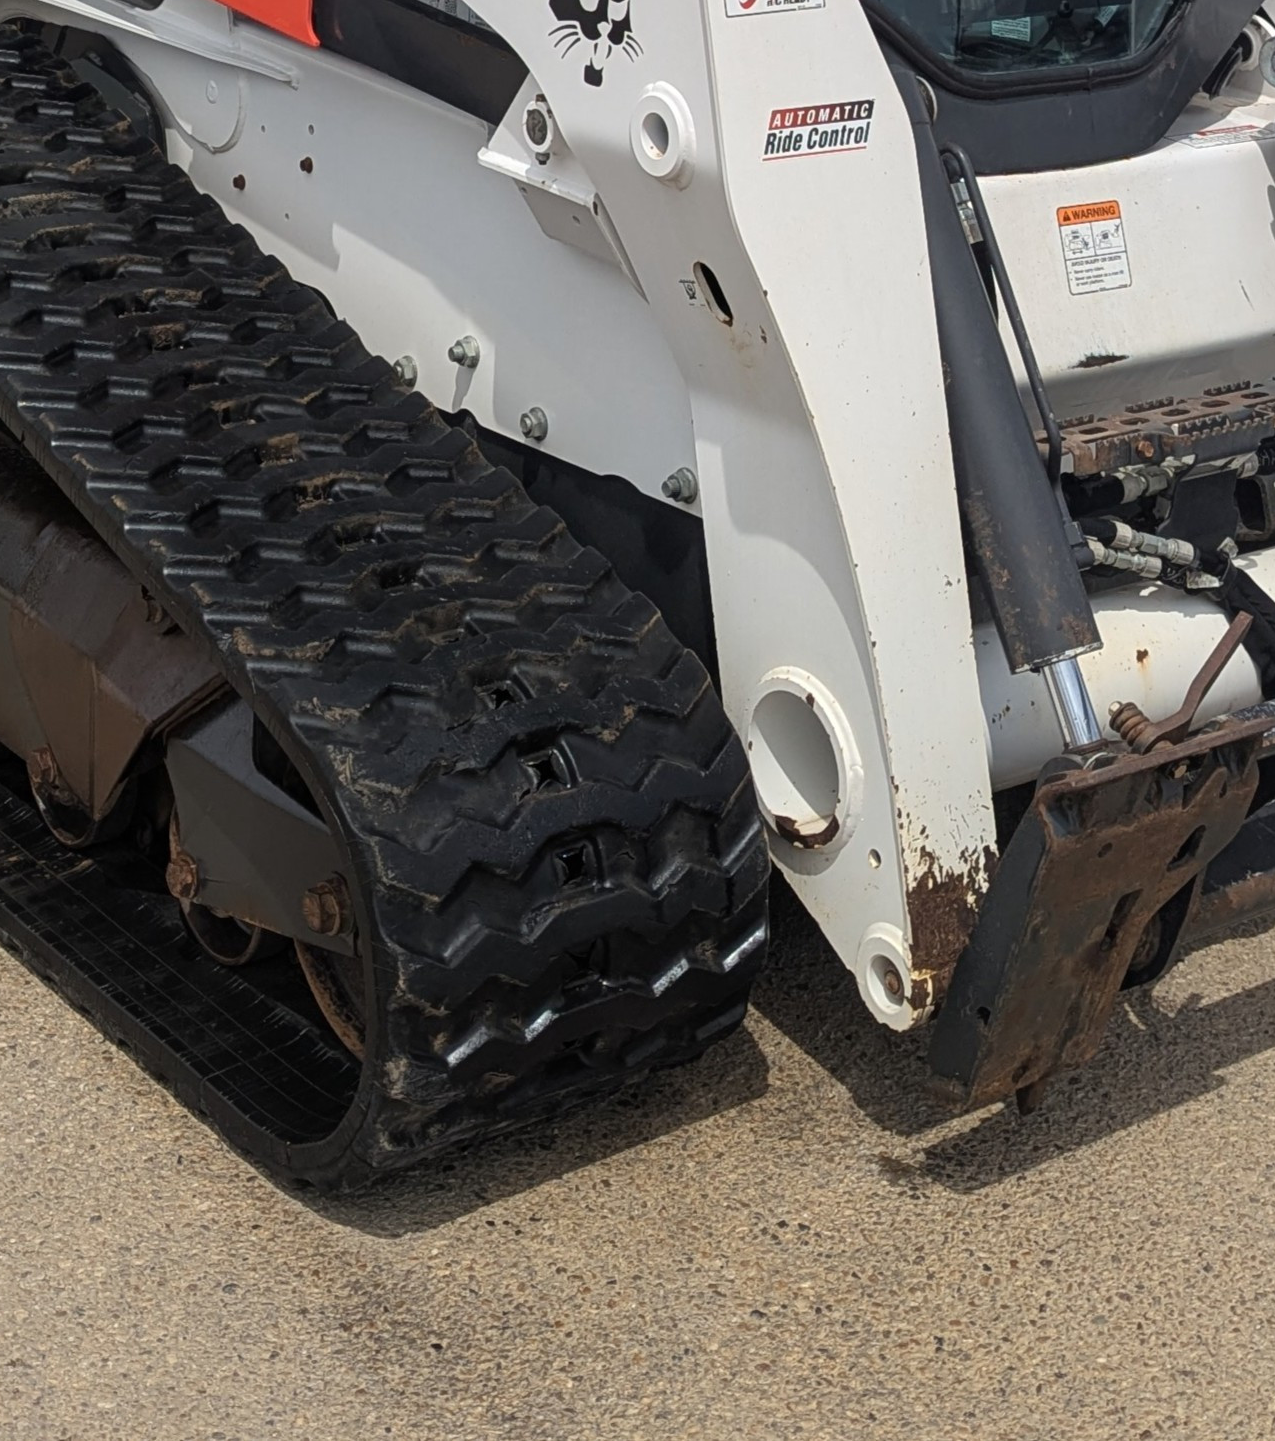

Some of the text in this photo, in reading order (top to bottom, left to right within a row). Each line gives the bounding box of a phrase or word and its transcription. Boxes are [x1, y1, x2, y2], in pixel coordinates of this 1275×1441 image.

[772, 103, 870, 128] AUTOMATIC
[764, 122, 870, 155] Ride Control
[1071, 205, 1116, 220] WARNING
